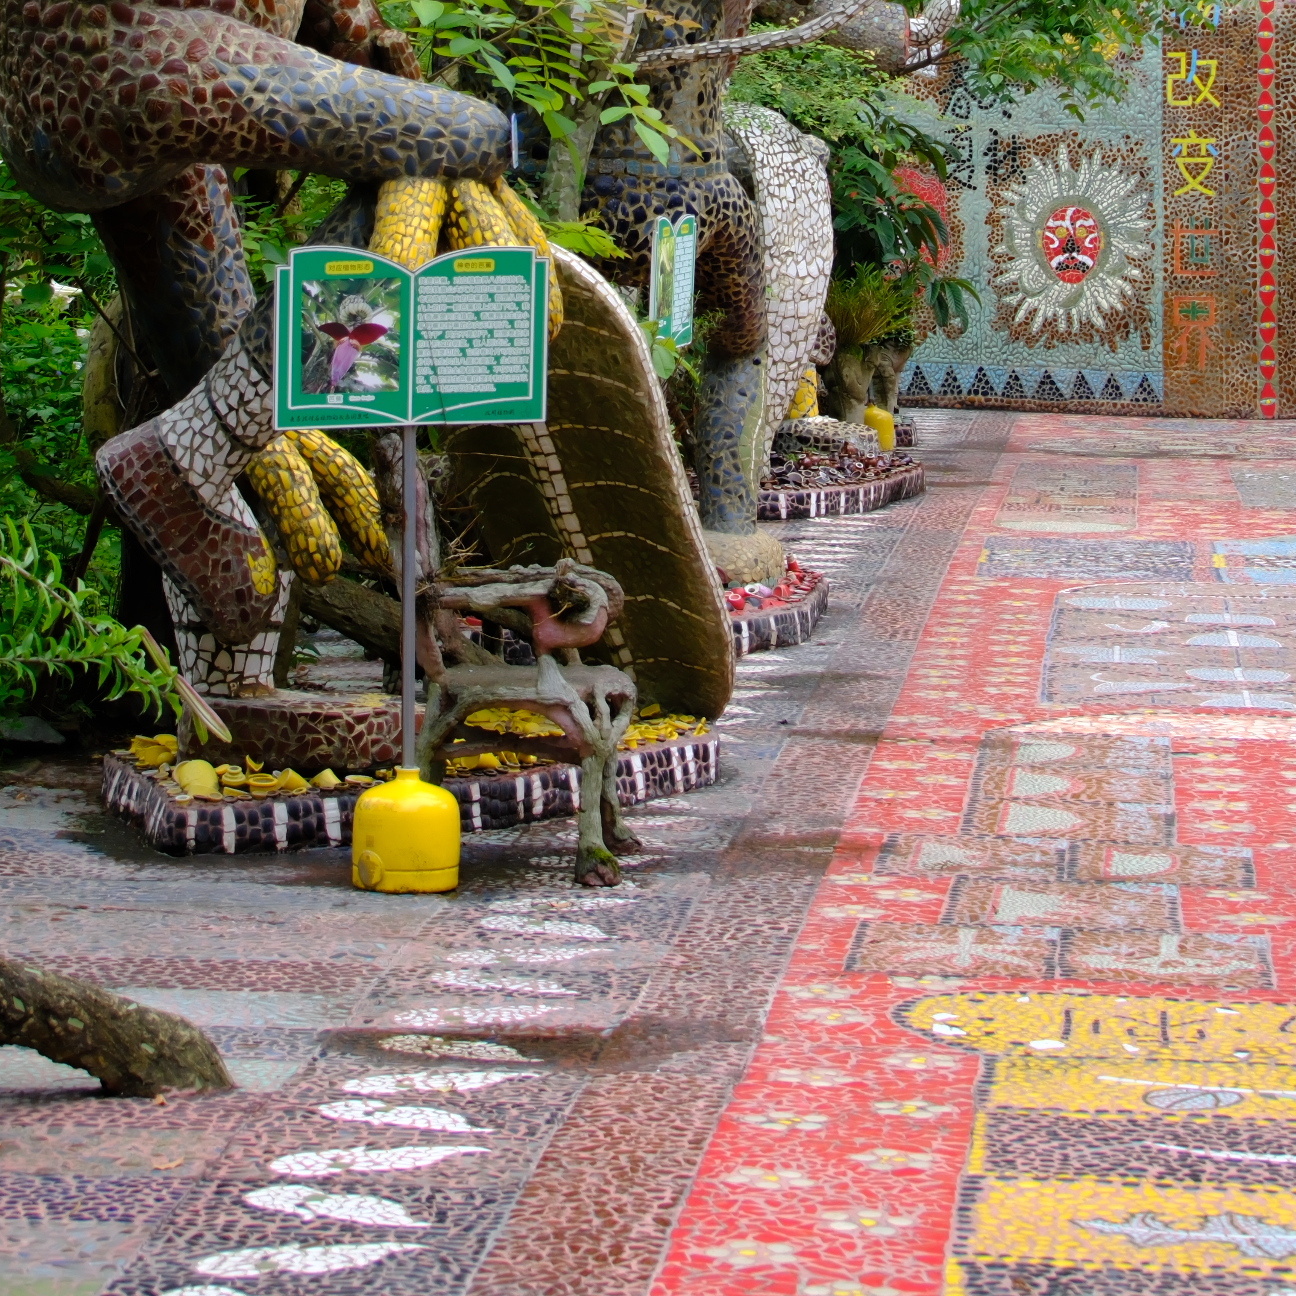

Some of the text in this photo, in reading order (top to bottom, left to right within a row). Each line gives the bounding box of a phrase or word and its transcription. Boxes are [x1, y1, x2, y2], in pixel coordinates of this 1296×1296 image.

[328, 263, 371, 272] 对应植物形态
[456, 261, 492, 269] 神奇的芭蕉
